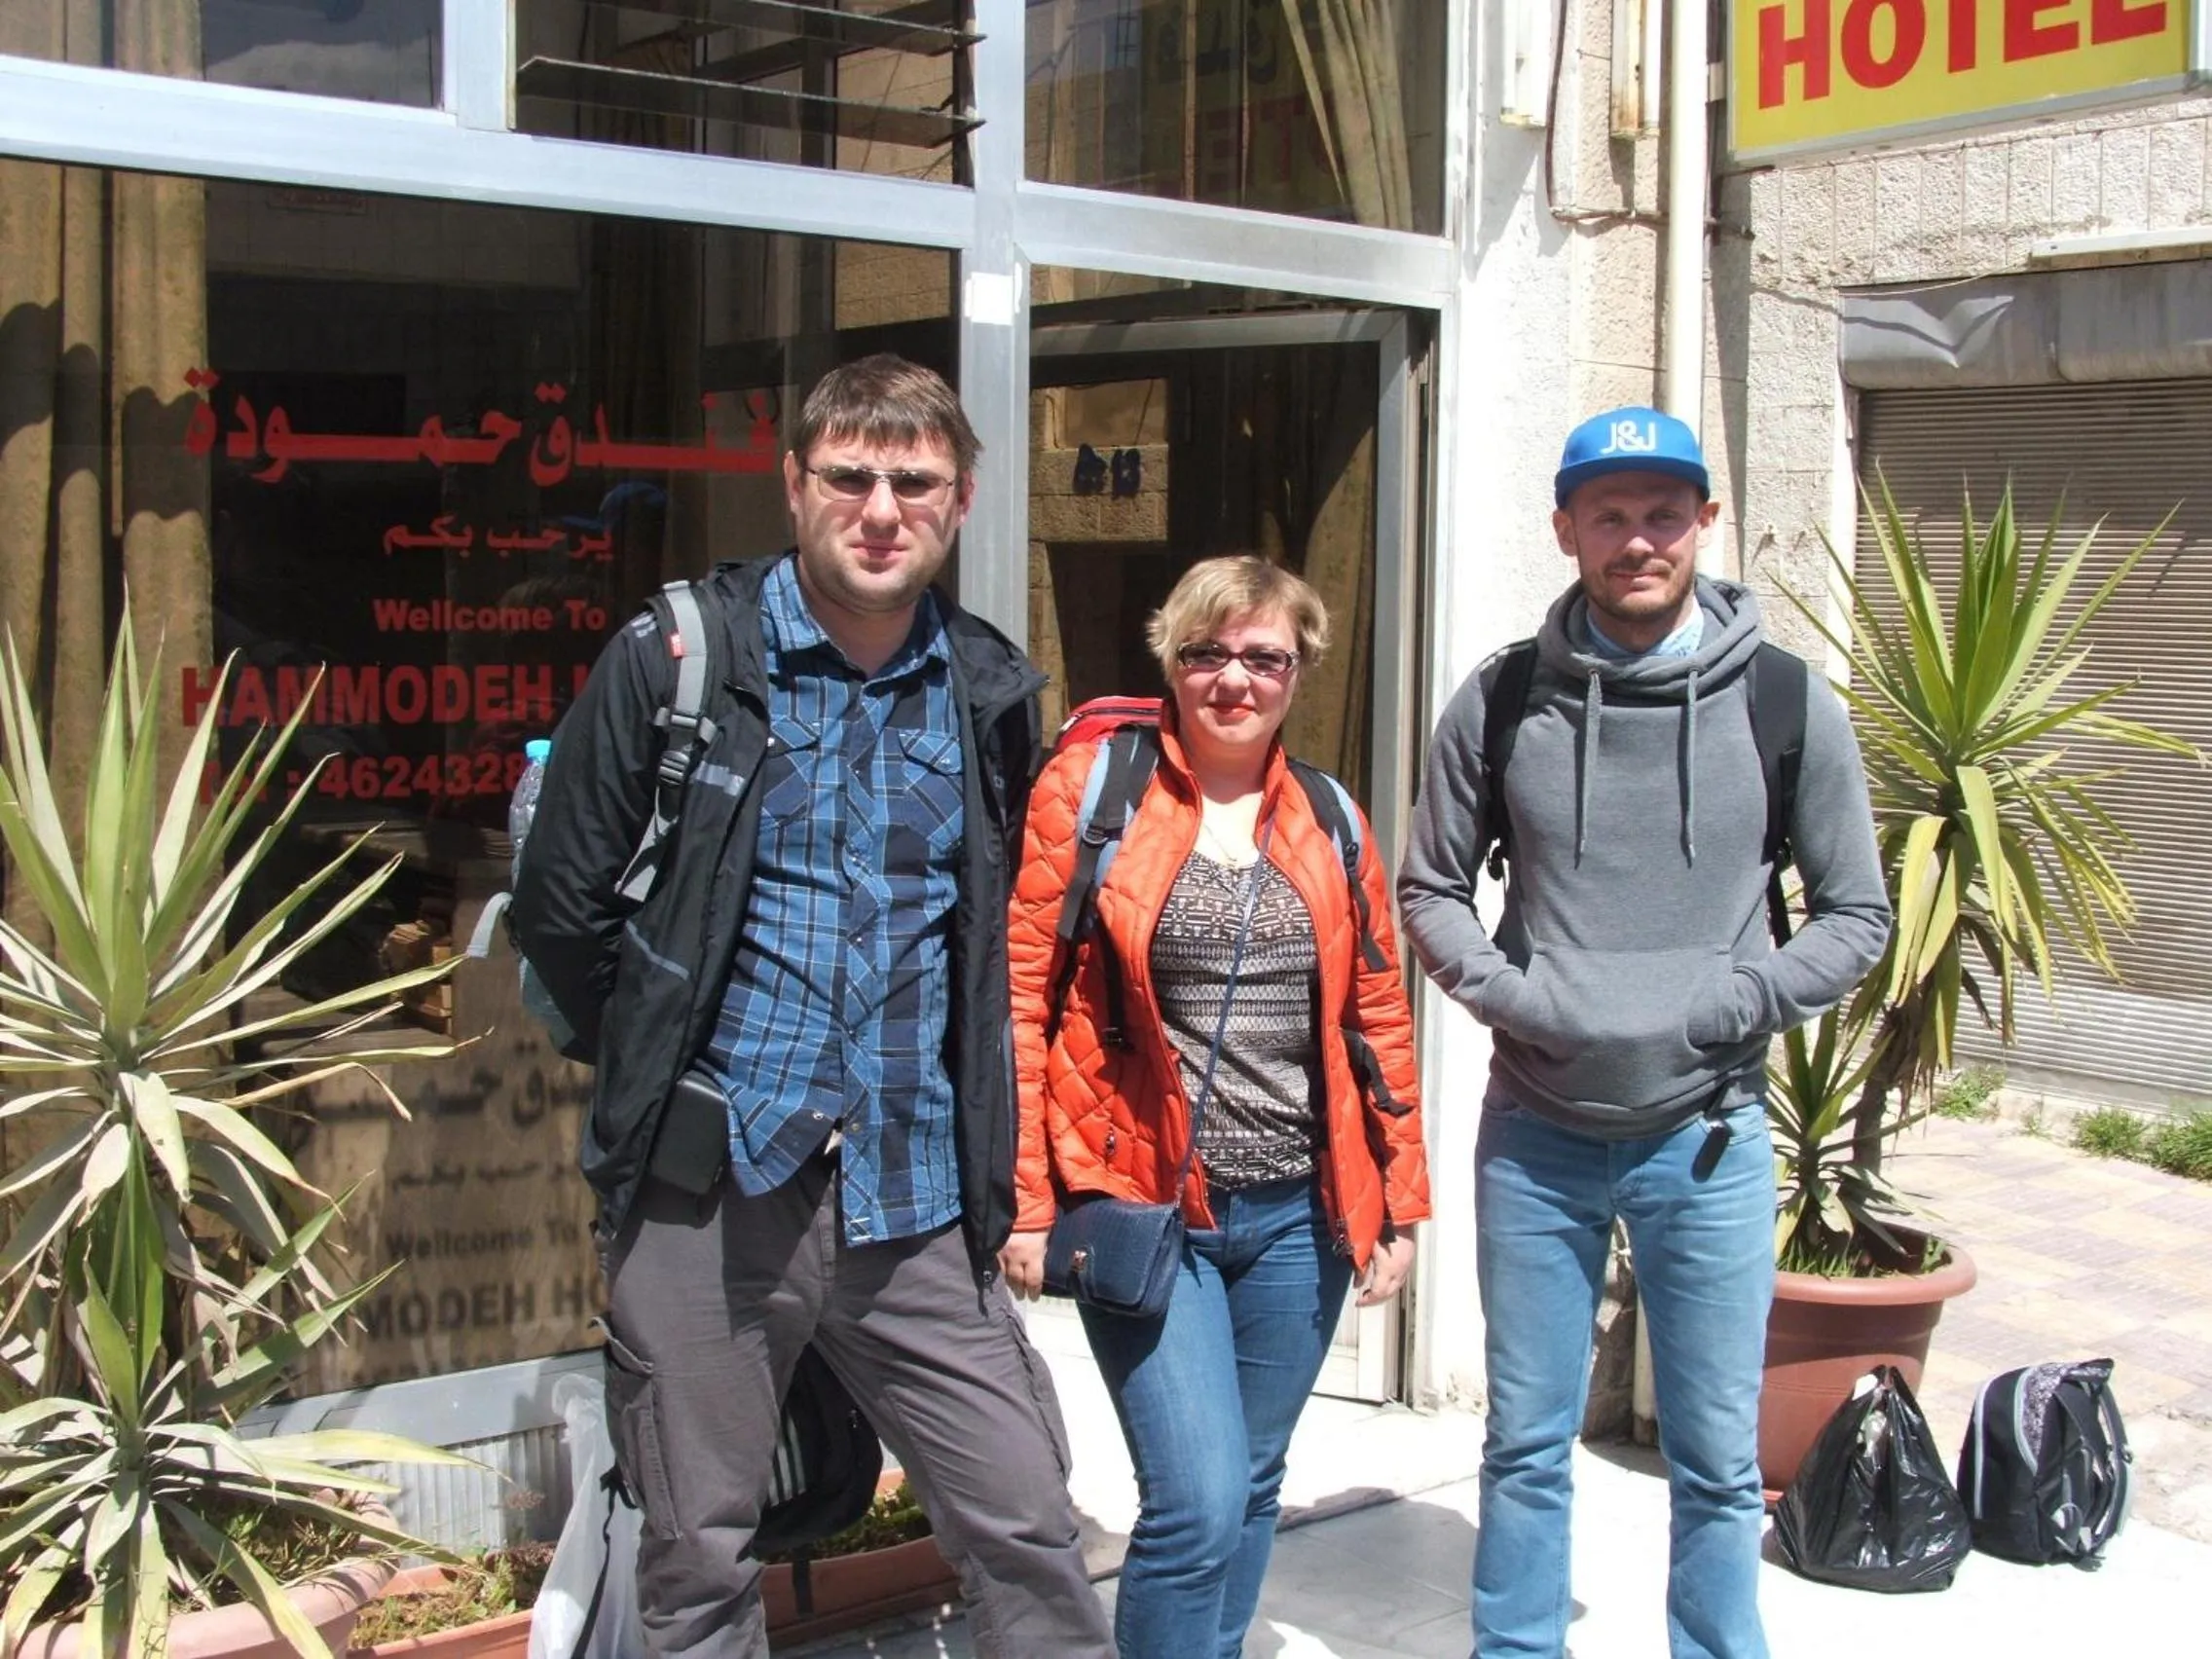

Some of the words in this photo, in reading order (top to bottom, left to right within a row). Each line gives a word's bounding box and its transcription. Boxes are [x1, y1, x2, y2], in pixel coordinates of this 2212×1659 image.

[184, 366, 523, 484] حمودة
[528, 382, 779, 487] فندق
[1600, 420, 1657, 455] J&J
[383, 514, 473, 559] بكم
[373, 599, 554, 632] Wellcome
[565, 599, 607, 630] To
[182, 664, 555, 727] HAMMODEH
[366, 1281, 535, 1339] MODEH
